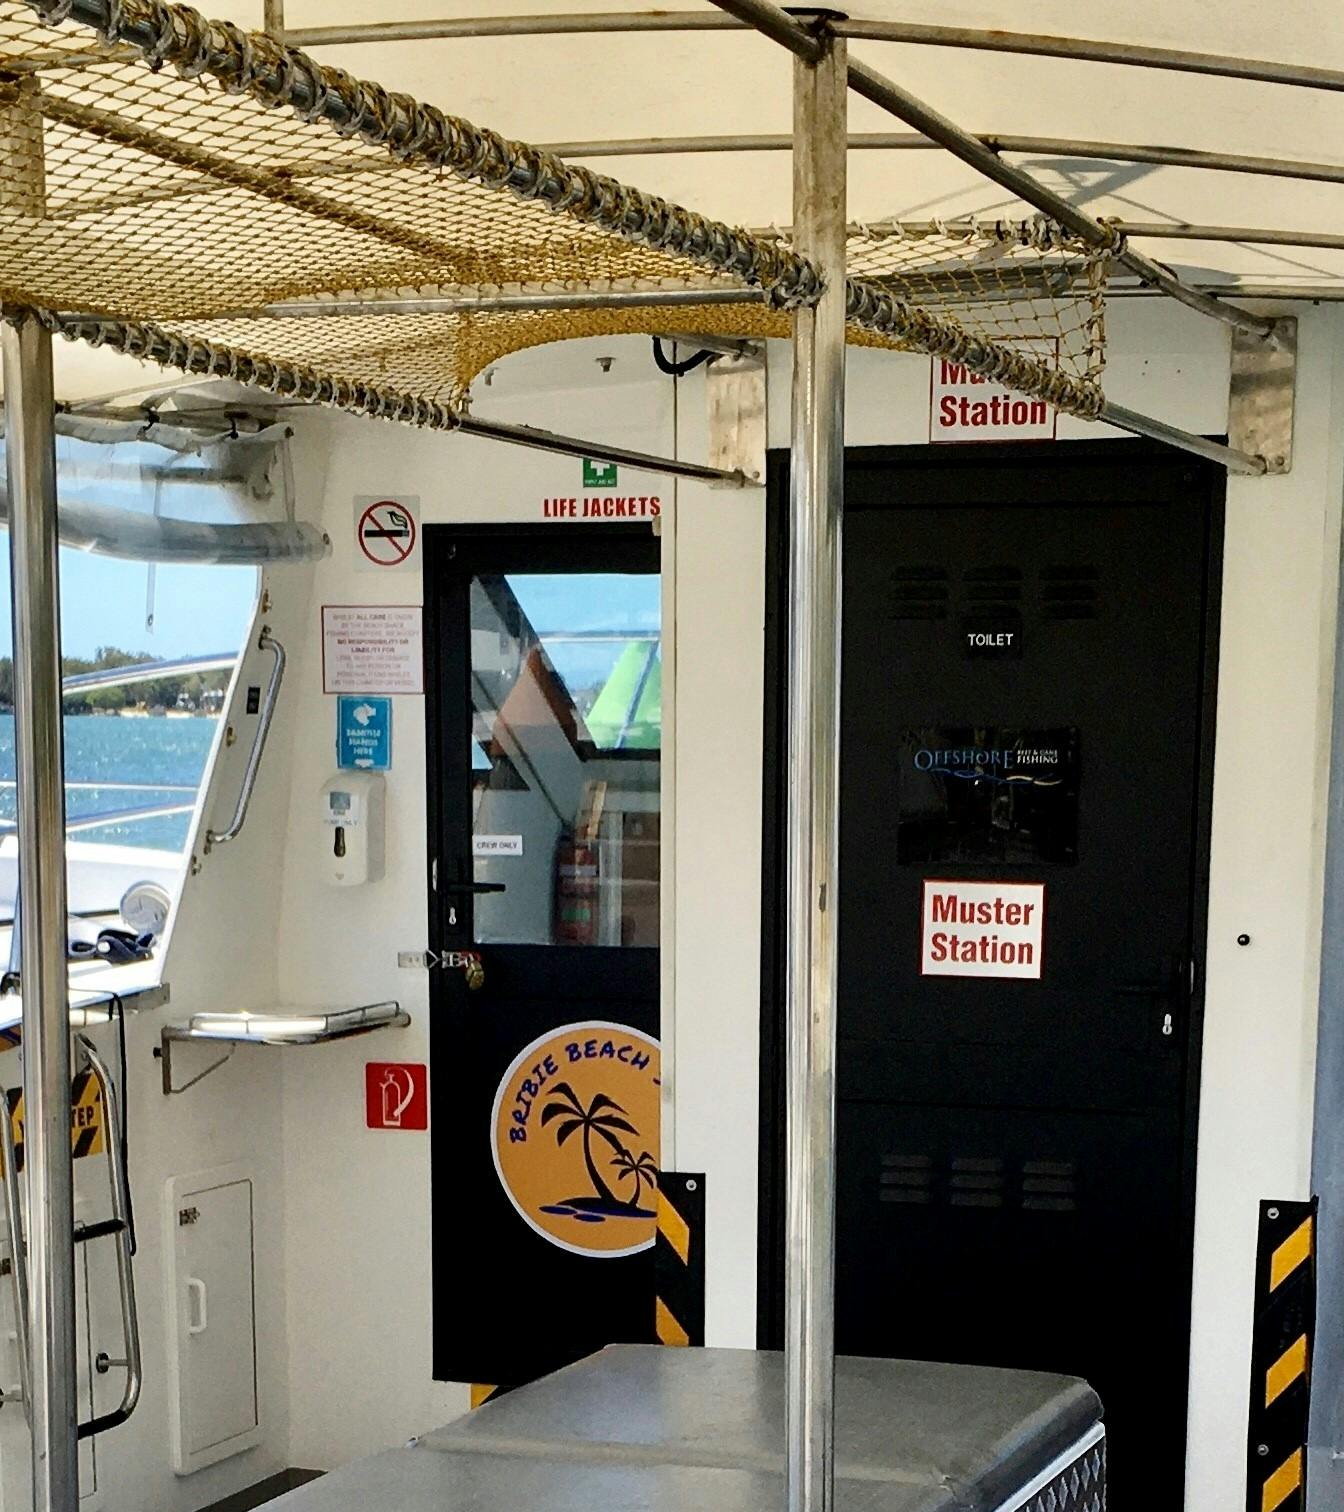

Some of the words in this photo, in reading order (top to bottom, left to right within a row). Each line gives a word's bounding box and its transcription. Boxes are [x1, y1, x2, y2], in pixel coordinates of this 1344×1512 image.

[939, 395, 1047, 427] Station
[544, 498, 577, 517] LIFE
[583, 496, 661, 517] JACKETS
[967, 633, 1014, 647] TOILET
[914, 749, 1014, 770] OFFSHORE
[1017, 755, 1058, 764] FISHING
[931, 894, 1035, 925] Muster
[931, 932, 1034, 965] Station
[509, 1054, 559, 1143] BRIBIE
[565, 1039, 650, 1070] BEACH
[71, 1105, 94, 1129] TEP
